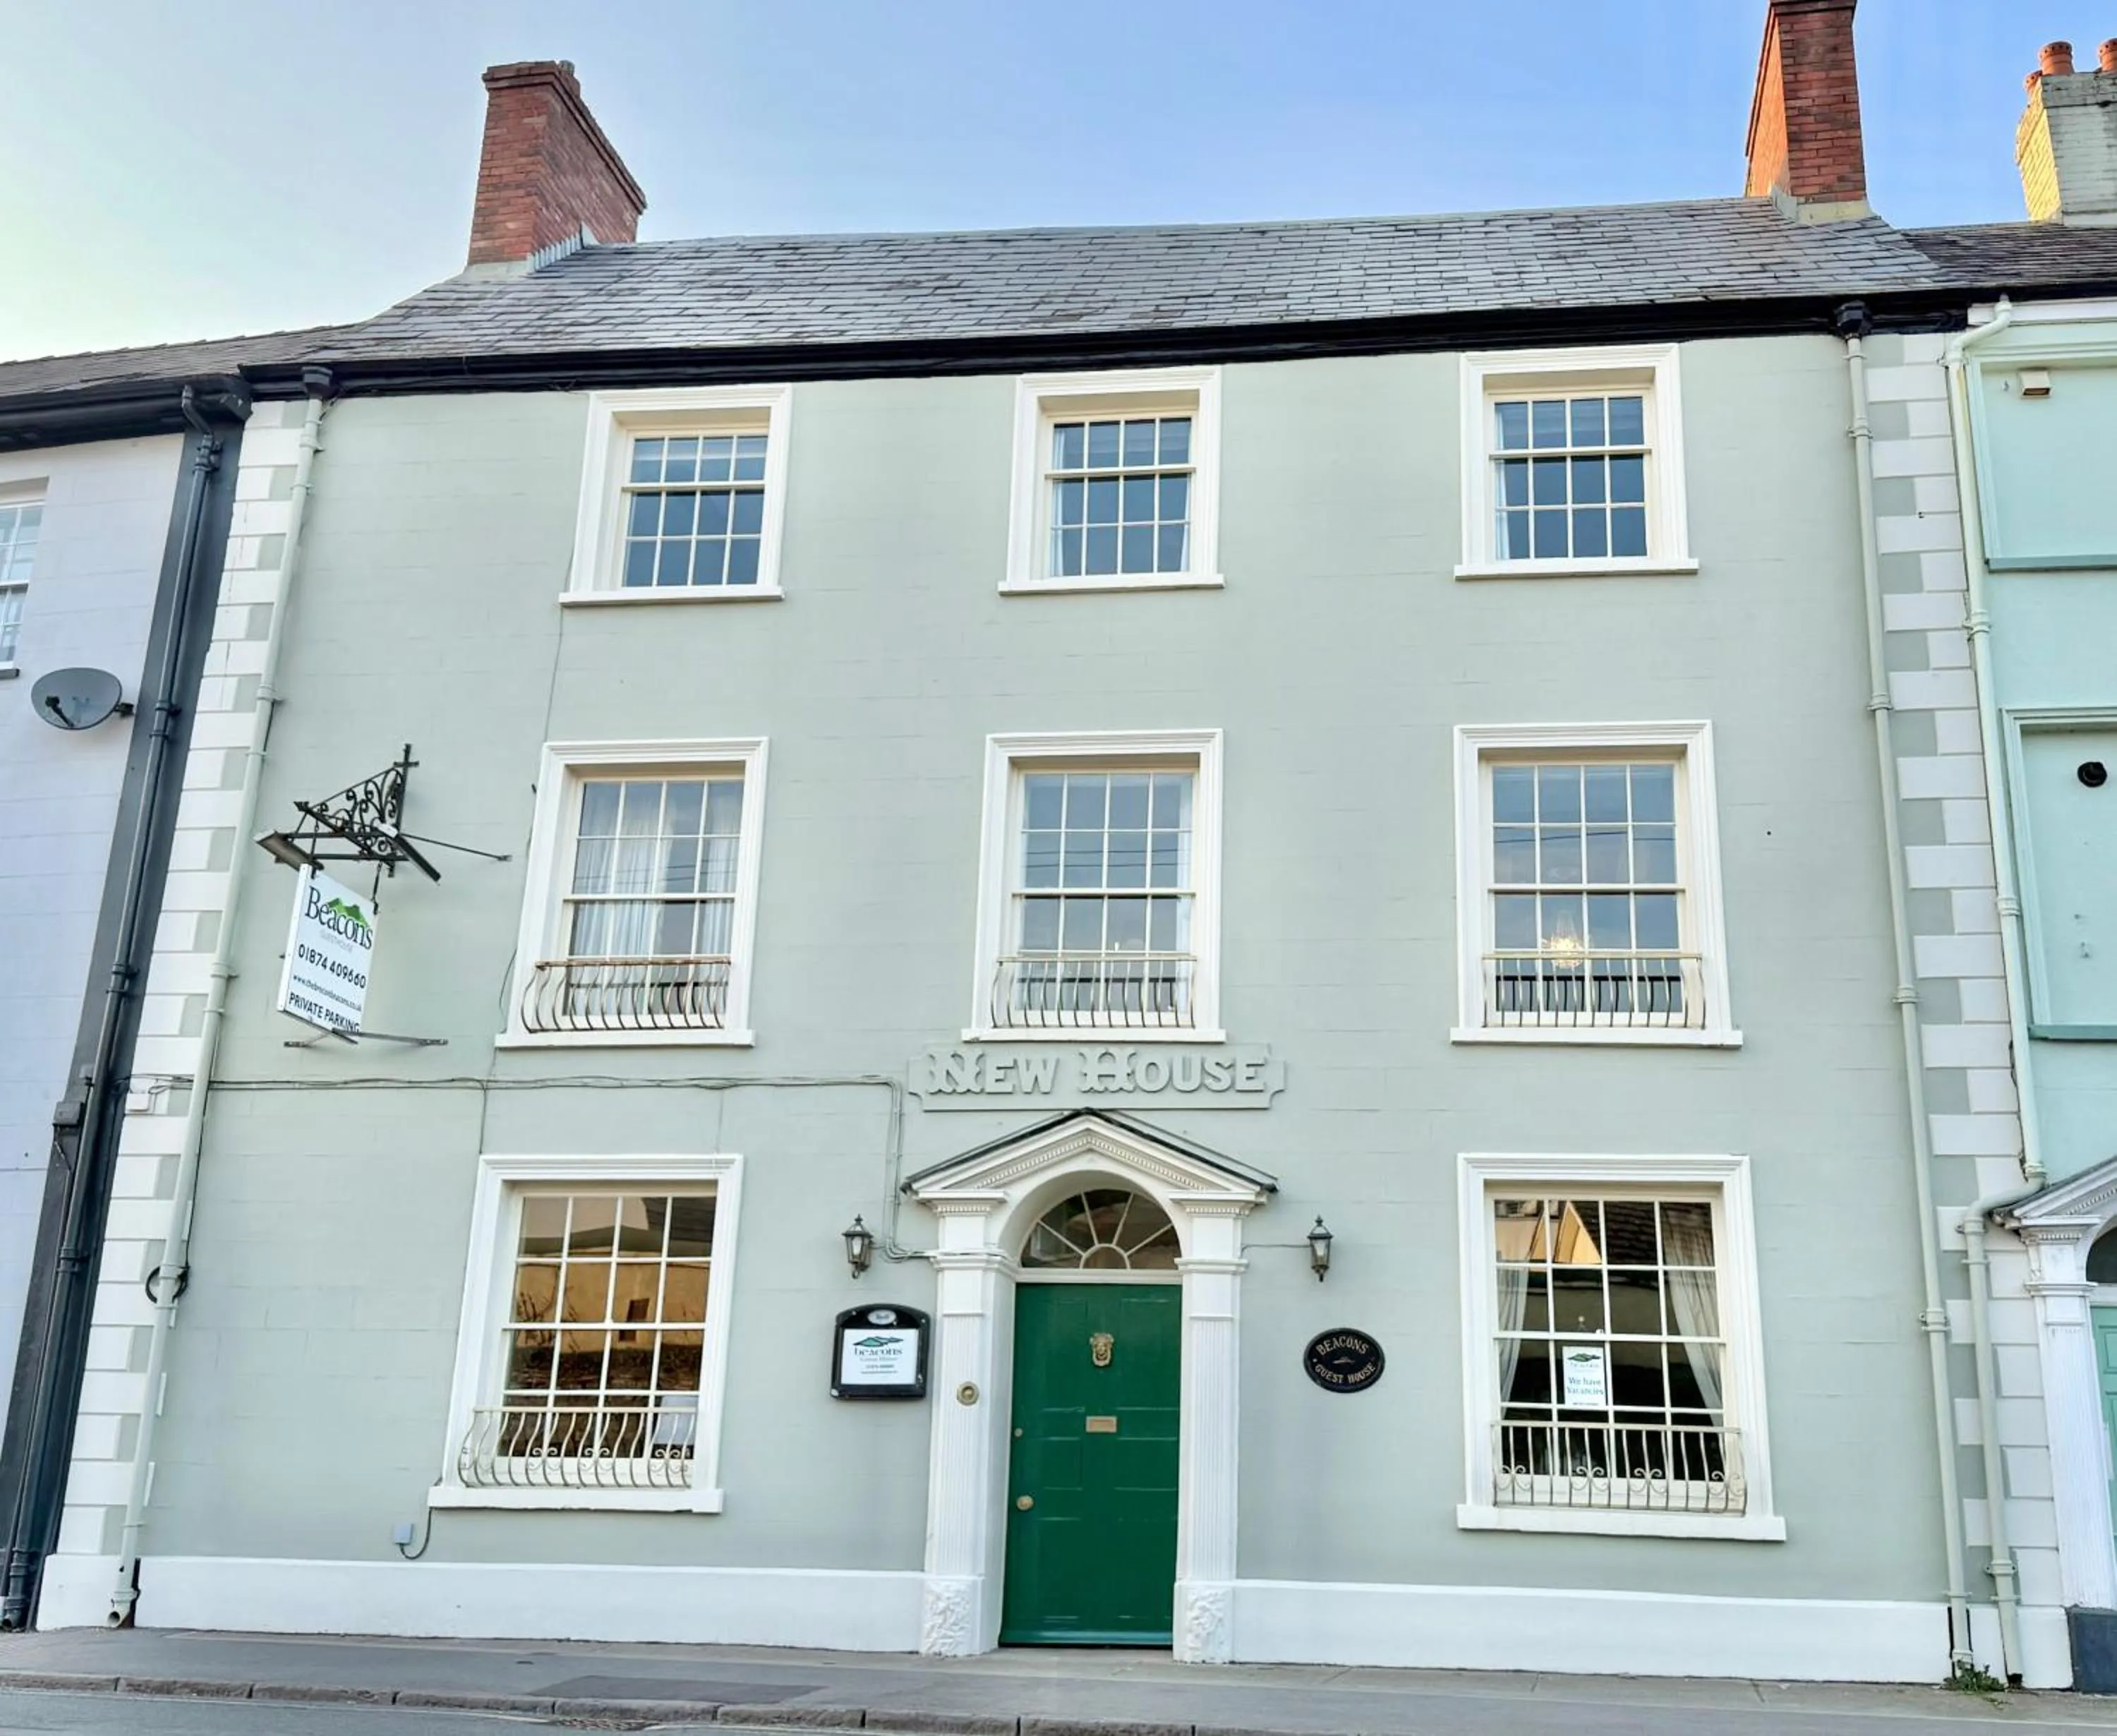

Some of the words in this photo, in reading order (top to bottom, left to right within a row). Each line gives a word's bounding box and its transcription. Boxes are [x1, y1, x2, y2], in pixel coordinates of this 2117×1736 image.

[305, 885, 373, 950] Beacons
[298, 944, 328, 970] 01874
[330, 960, 366, 989] 409660
[289, 991, 323, 1018] PRIVATE
[325, 1008, 360, 1034] PARKING
[926, 1049, 1060, 1095] NEW
[1078, 1048, 1266, 1093] HOUSE
[1315, 1336, 1369, 1355] BEACONS
[1315, 1364, 1344, 1383] GUEST
[1347, 1362, 1375, 1383] HOUSE
